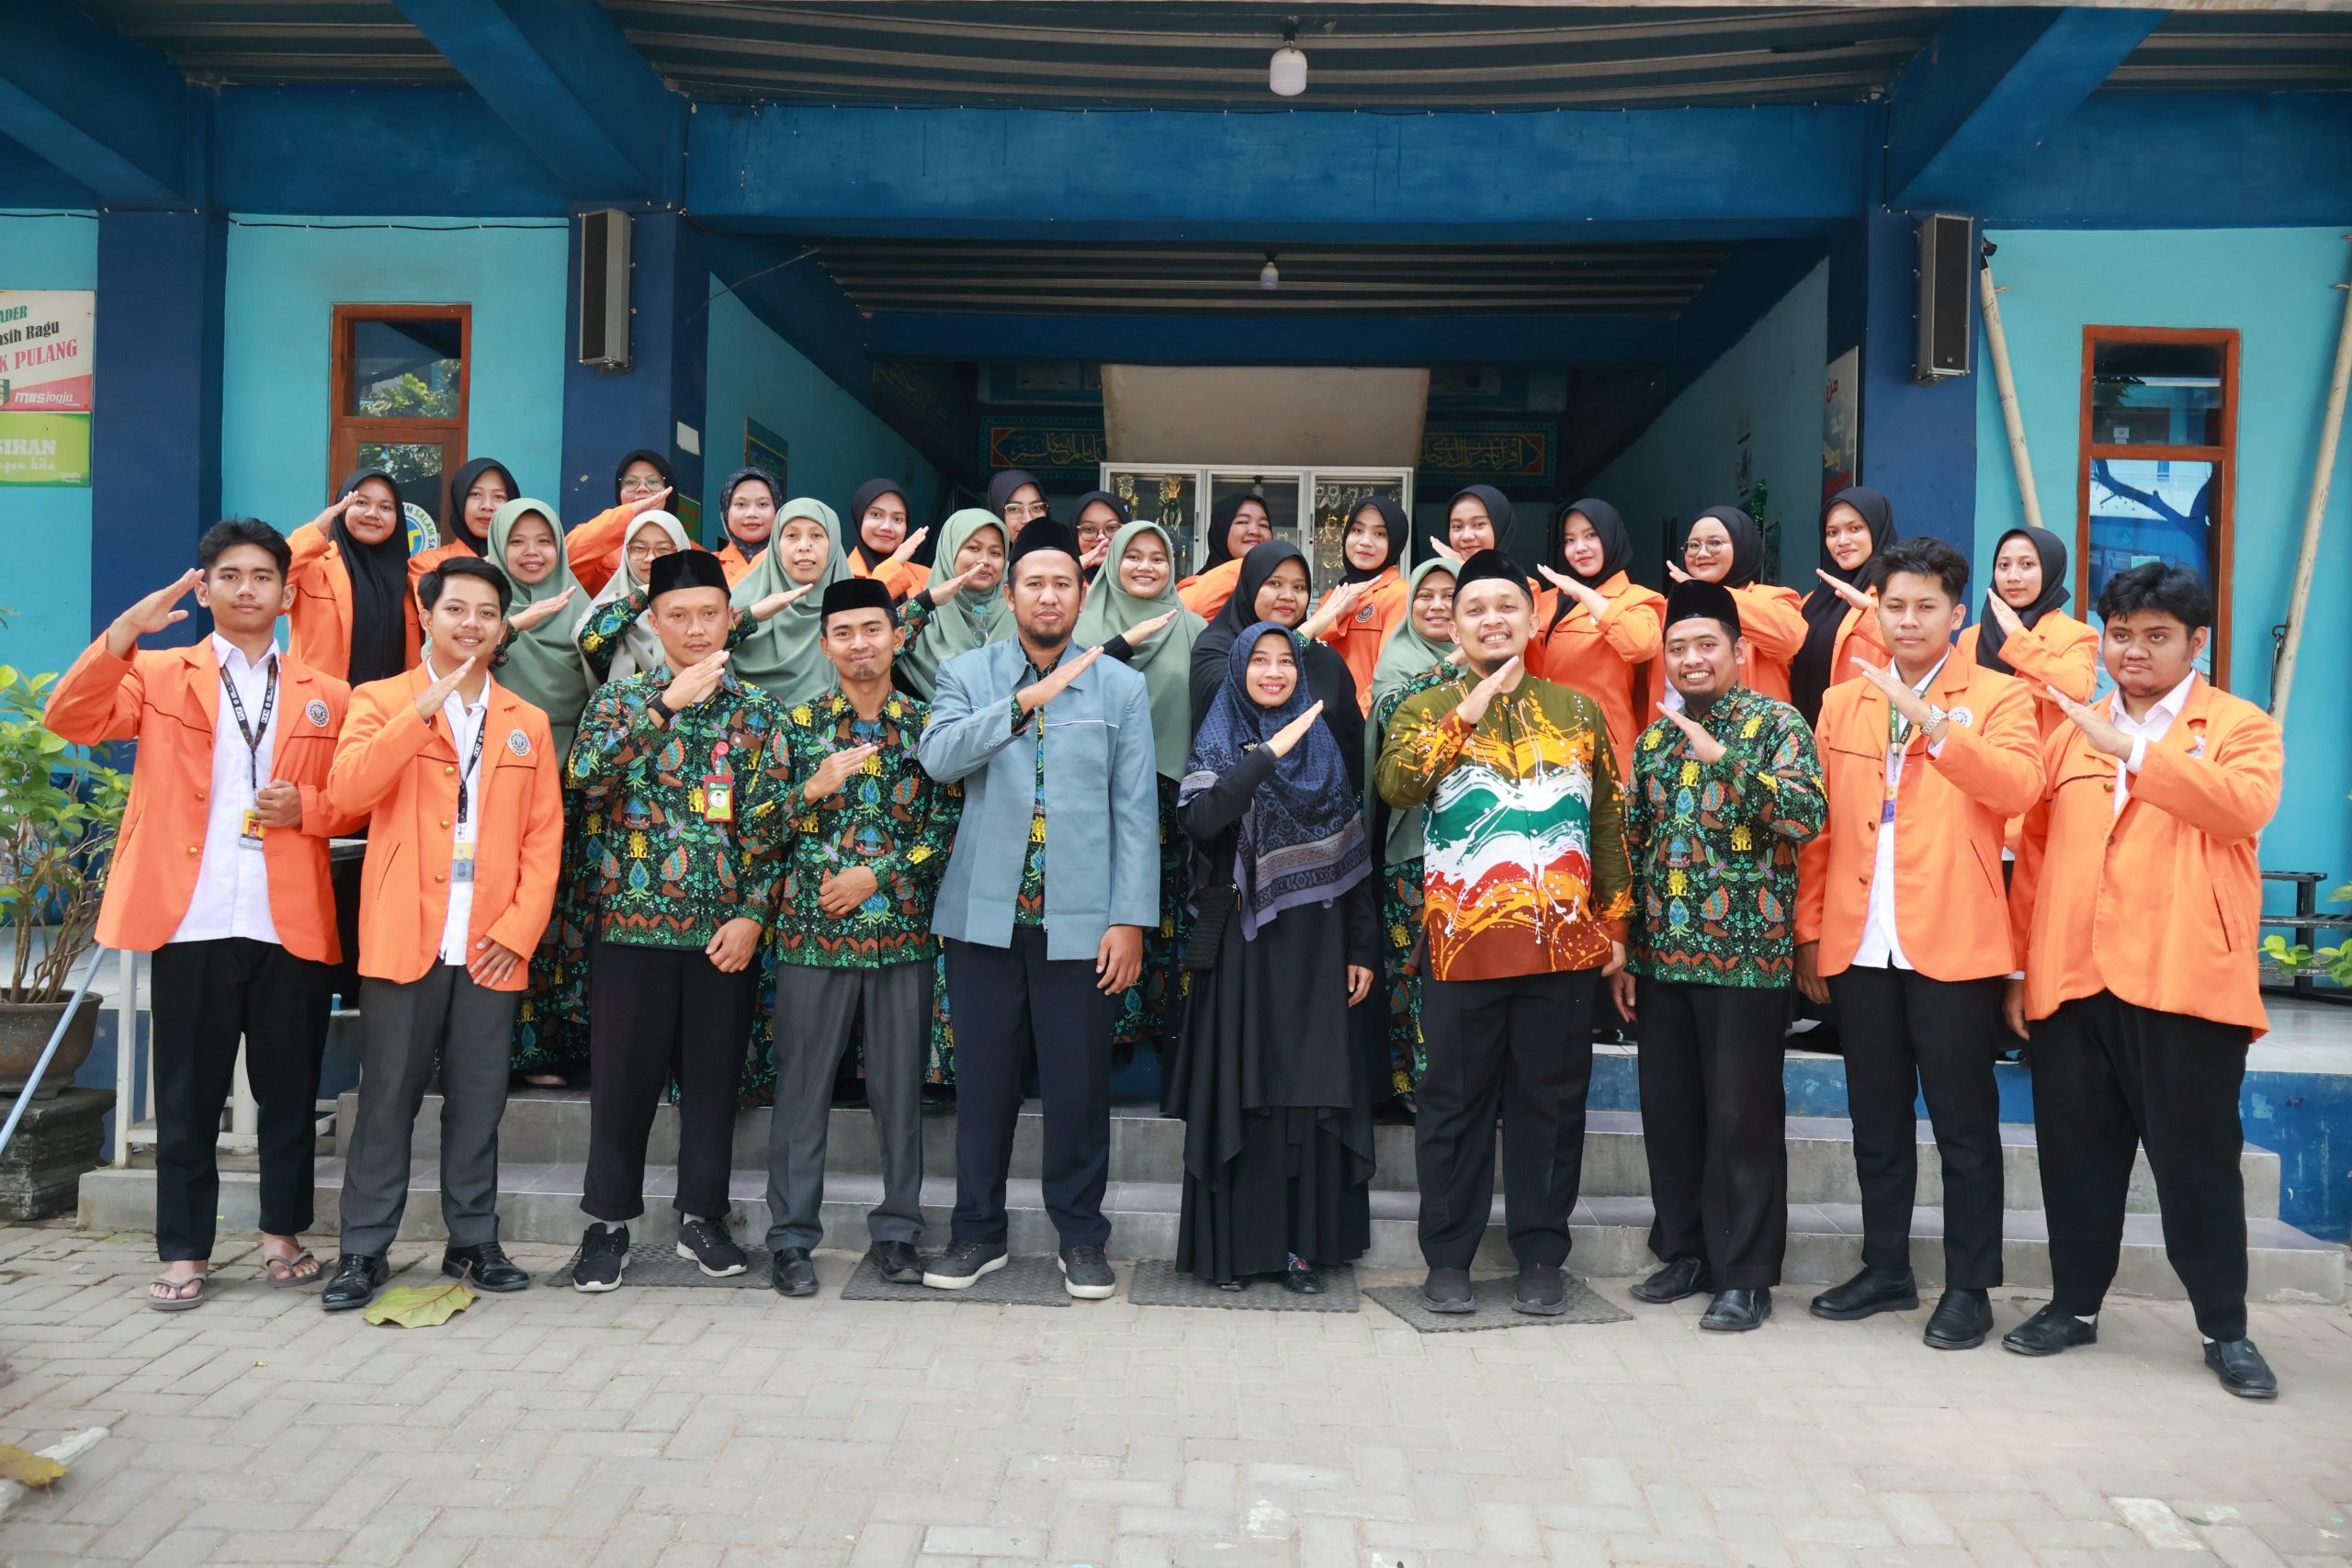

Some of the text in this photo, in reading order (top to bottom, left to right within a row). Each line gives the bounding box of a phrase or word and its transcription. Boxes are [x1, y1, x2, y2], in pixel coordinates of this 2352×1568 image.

[26, 321, 60, 340] Ragu
[15, 339, 78, 369] PULANG
[414, 509, 435, 537] SALAM
